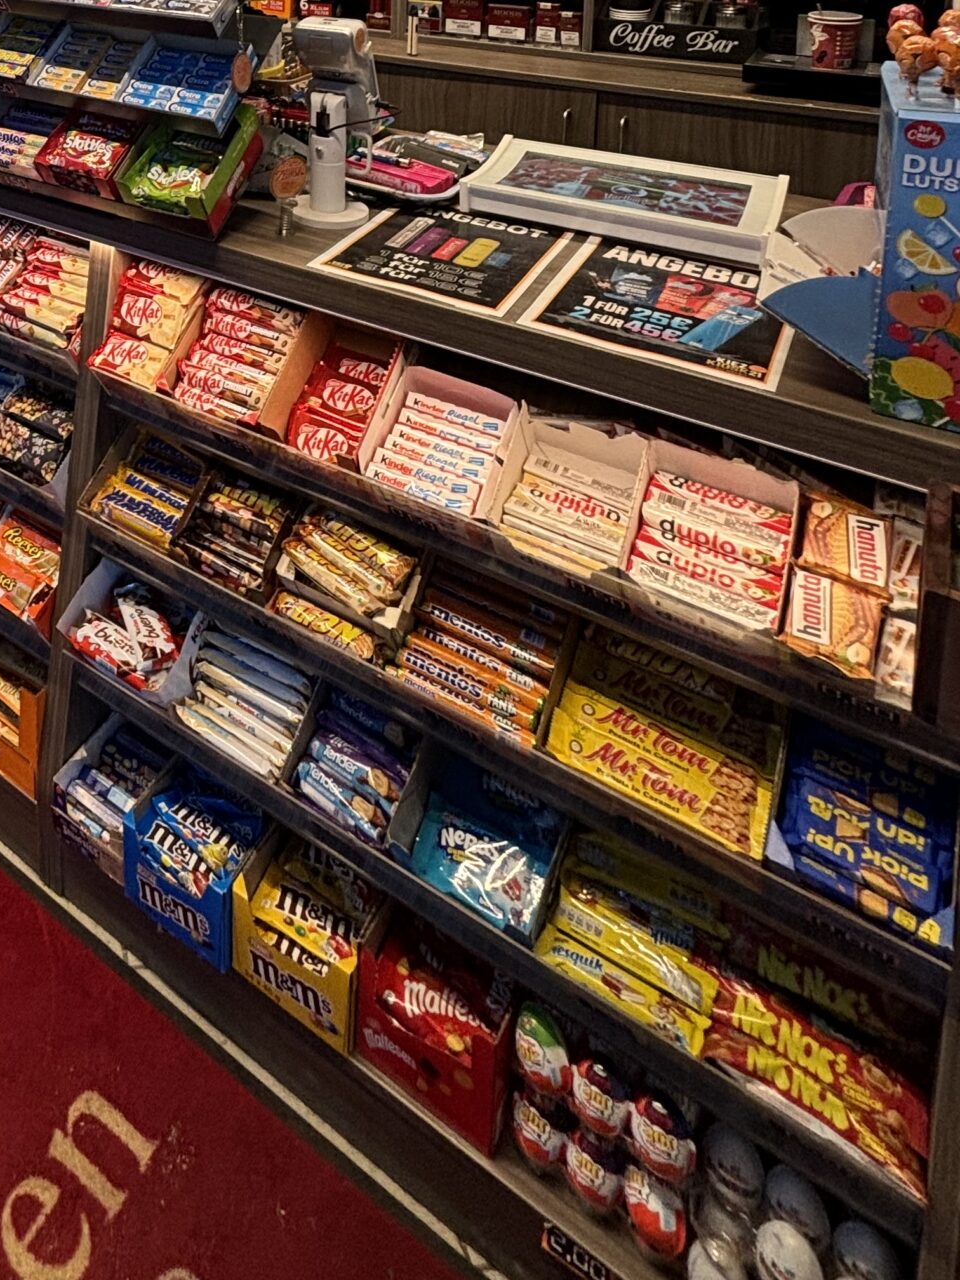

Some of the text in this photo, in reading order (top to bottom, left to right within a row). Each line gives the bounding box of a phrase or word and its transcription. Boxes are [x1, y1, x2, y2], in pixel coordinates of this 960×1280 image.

[608, 22, 740, 55] Coffee Bar
[379, 266, 417, 281] für
[388, 260, 427, 274] für
[392, 252, 431, 266] für
[124, 298, 162, 327] KitKat
[211, 317, 251, 337] KitKat
[569, 305, 683, 344] 2 FÜR 45€
[583, 294, 695, 332] 1 FÜR 25€
[111, 340, 149, 365] KitKat
[322, 381, 376, 411] KitKat
[413, 396, 481, 426] kinder Riegel
[297, 426, 349, 459] KitKat
[399, 429, 434, 447] kinder
[379, 453, 448, 488] kinder Riegel
[659, 514, 738, 557] duplo
[854, 518, 881, 584] hanuta
[655, 548, 736, 590] duplo
[794, 572, 824, 641] hanuta
[403, 651, 485, 700] mentos
[403, 675, 438, 699] mentos
[322, 747, 359, 774] Tender
[648, 720, 714, 775] Tom
[307, 761, 344, 795] Tender
[636, 757, 705, 814] Tom
[642, 789, 681, 814] Caramel
[140, 882, 210, 936] m&m's
[249, 949, 333, 1018] m&m's
[362, 1026, 417, 1071] Maltesers
